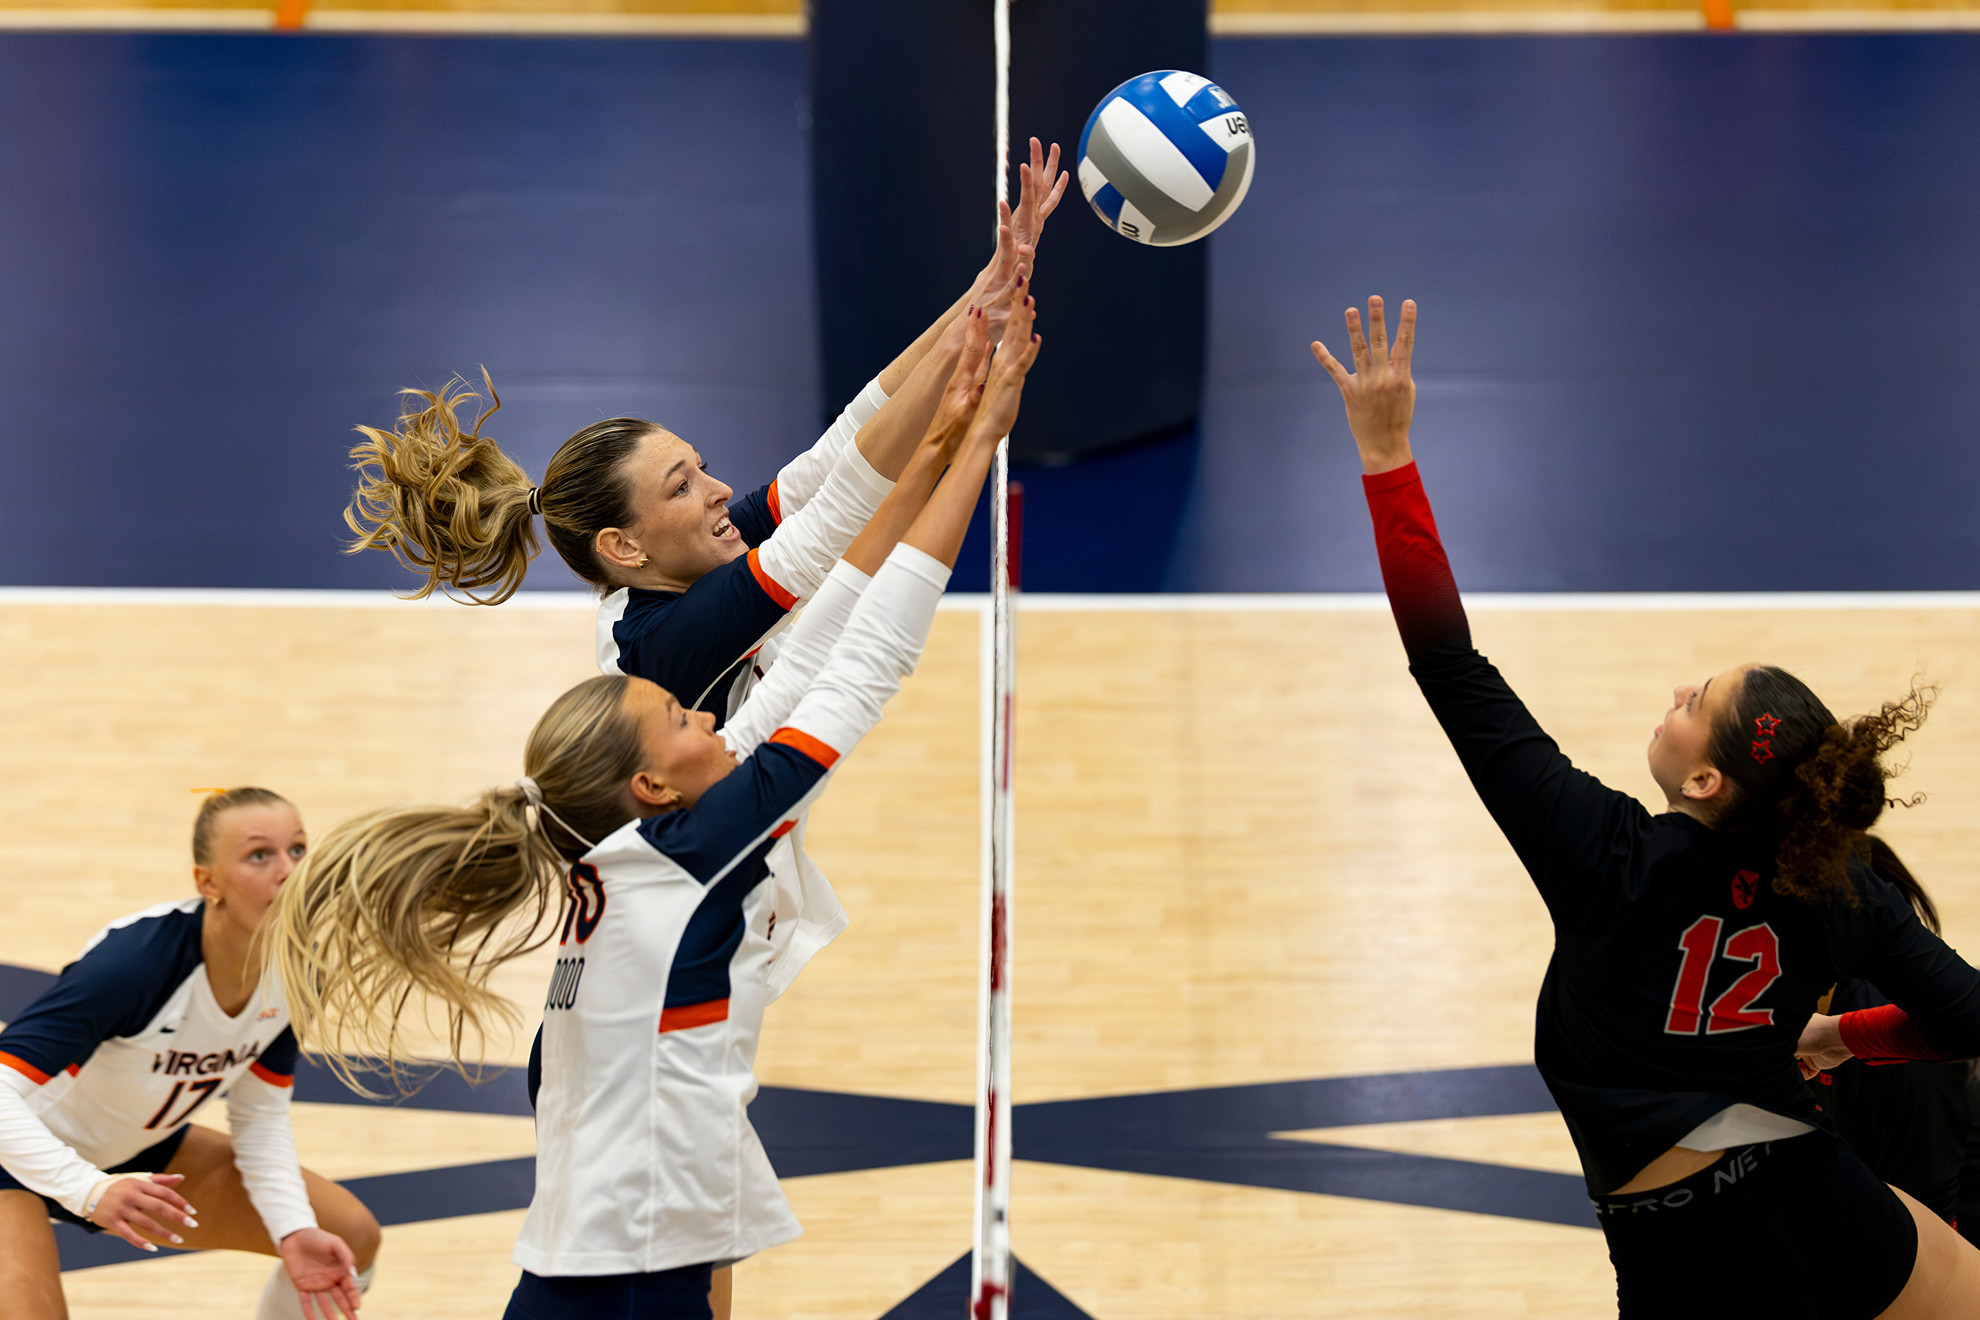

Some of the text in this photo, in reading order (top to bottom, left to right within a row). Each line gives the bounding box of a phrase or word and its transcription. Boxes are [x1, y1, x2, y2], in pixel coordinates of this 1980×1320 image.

[1225, 117, 1250, 136] en
[559, 860, 606, 946] 10
[1663, 914, 1783, 1036] 12
[143, 1077, 224, 1130] 17
